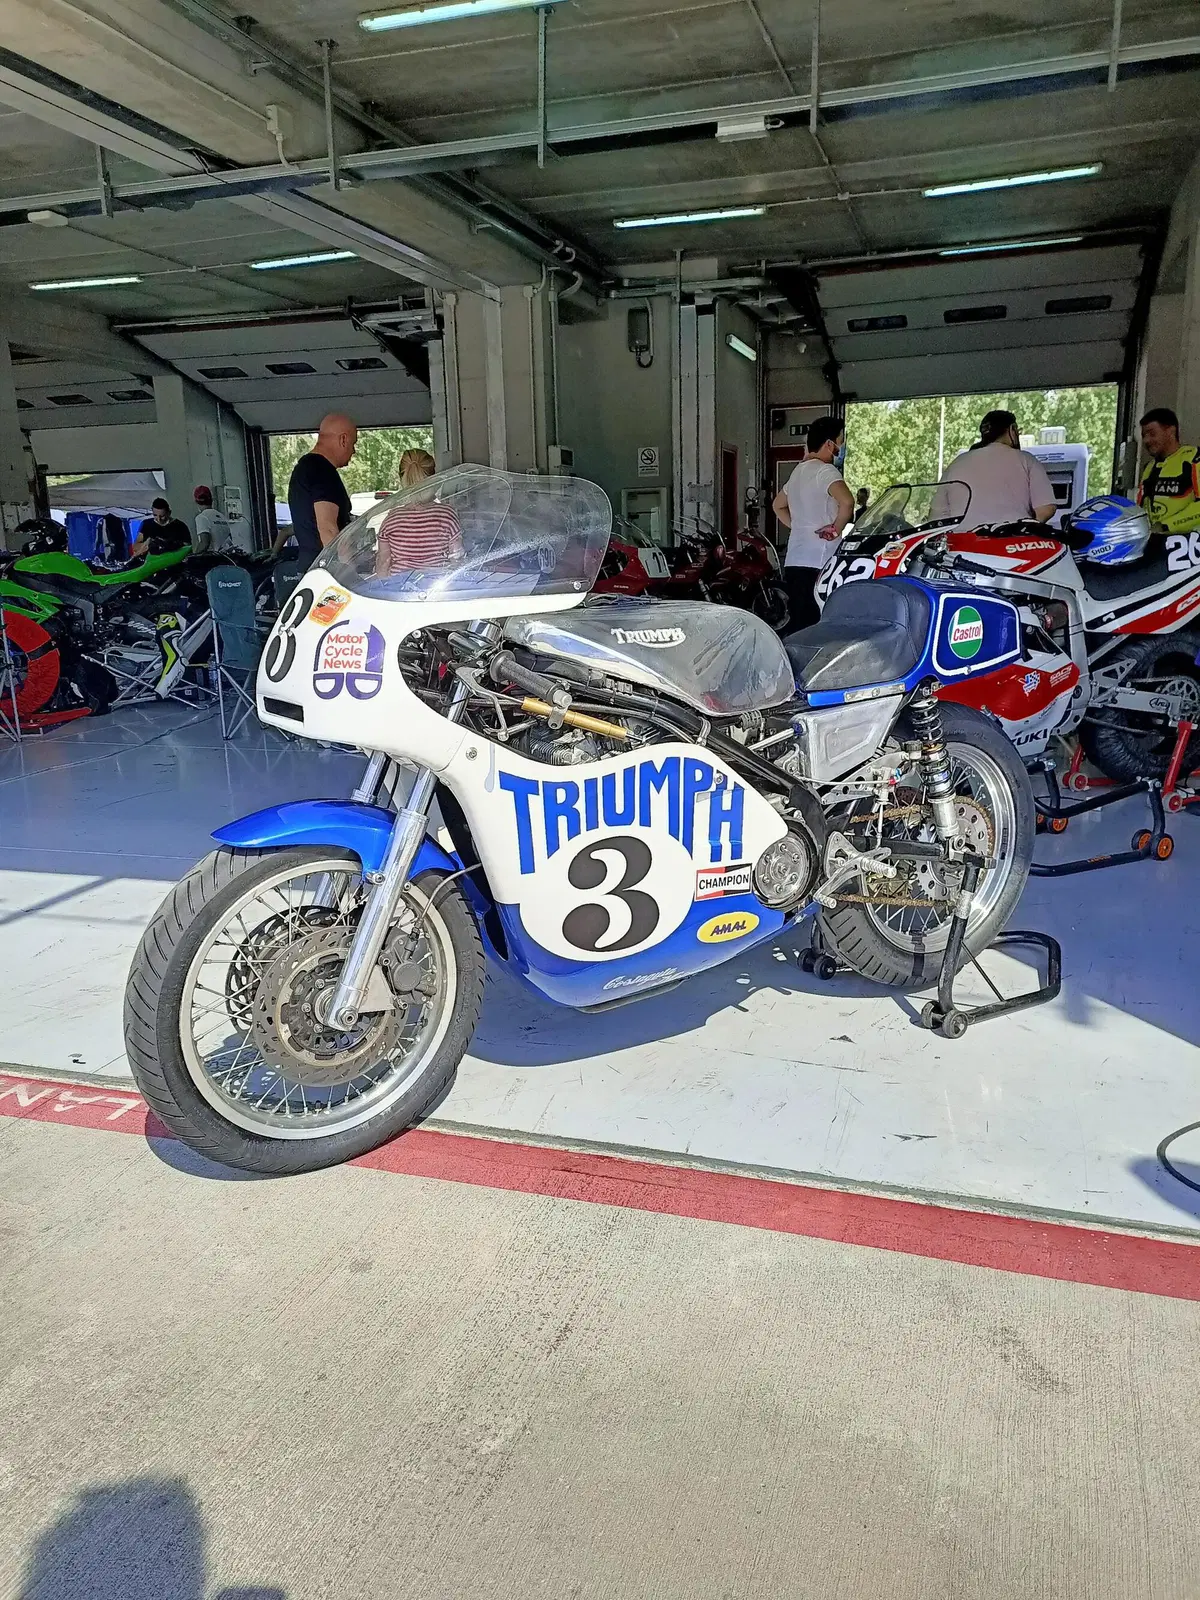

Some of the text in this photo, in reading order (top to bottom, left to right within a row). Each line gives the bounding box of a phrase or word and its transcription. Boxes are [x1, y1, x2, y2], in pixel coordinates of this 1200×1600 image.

[1005, 541, 1055, 554] SUZUKI
[1091, 544, 1112, 556] SHOEI
[816, 555, 876, 597] 262
[326, 633, 365, 644] Motor
[611, 627, 686, 647] TRIUMPH
[953, 624, 982, 641] Castrol
[325, 645, 363, 659] Cycle
[323, 658, 362, 669] News
[498, 756, 748, 875] TRIUMPH
[699, 873, 750, 890] CHAMPION
[562, 835, 660, 952] 3
[710, 920, 747, 936] AMAL
